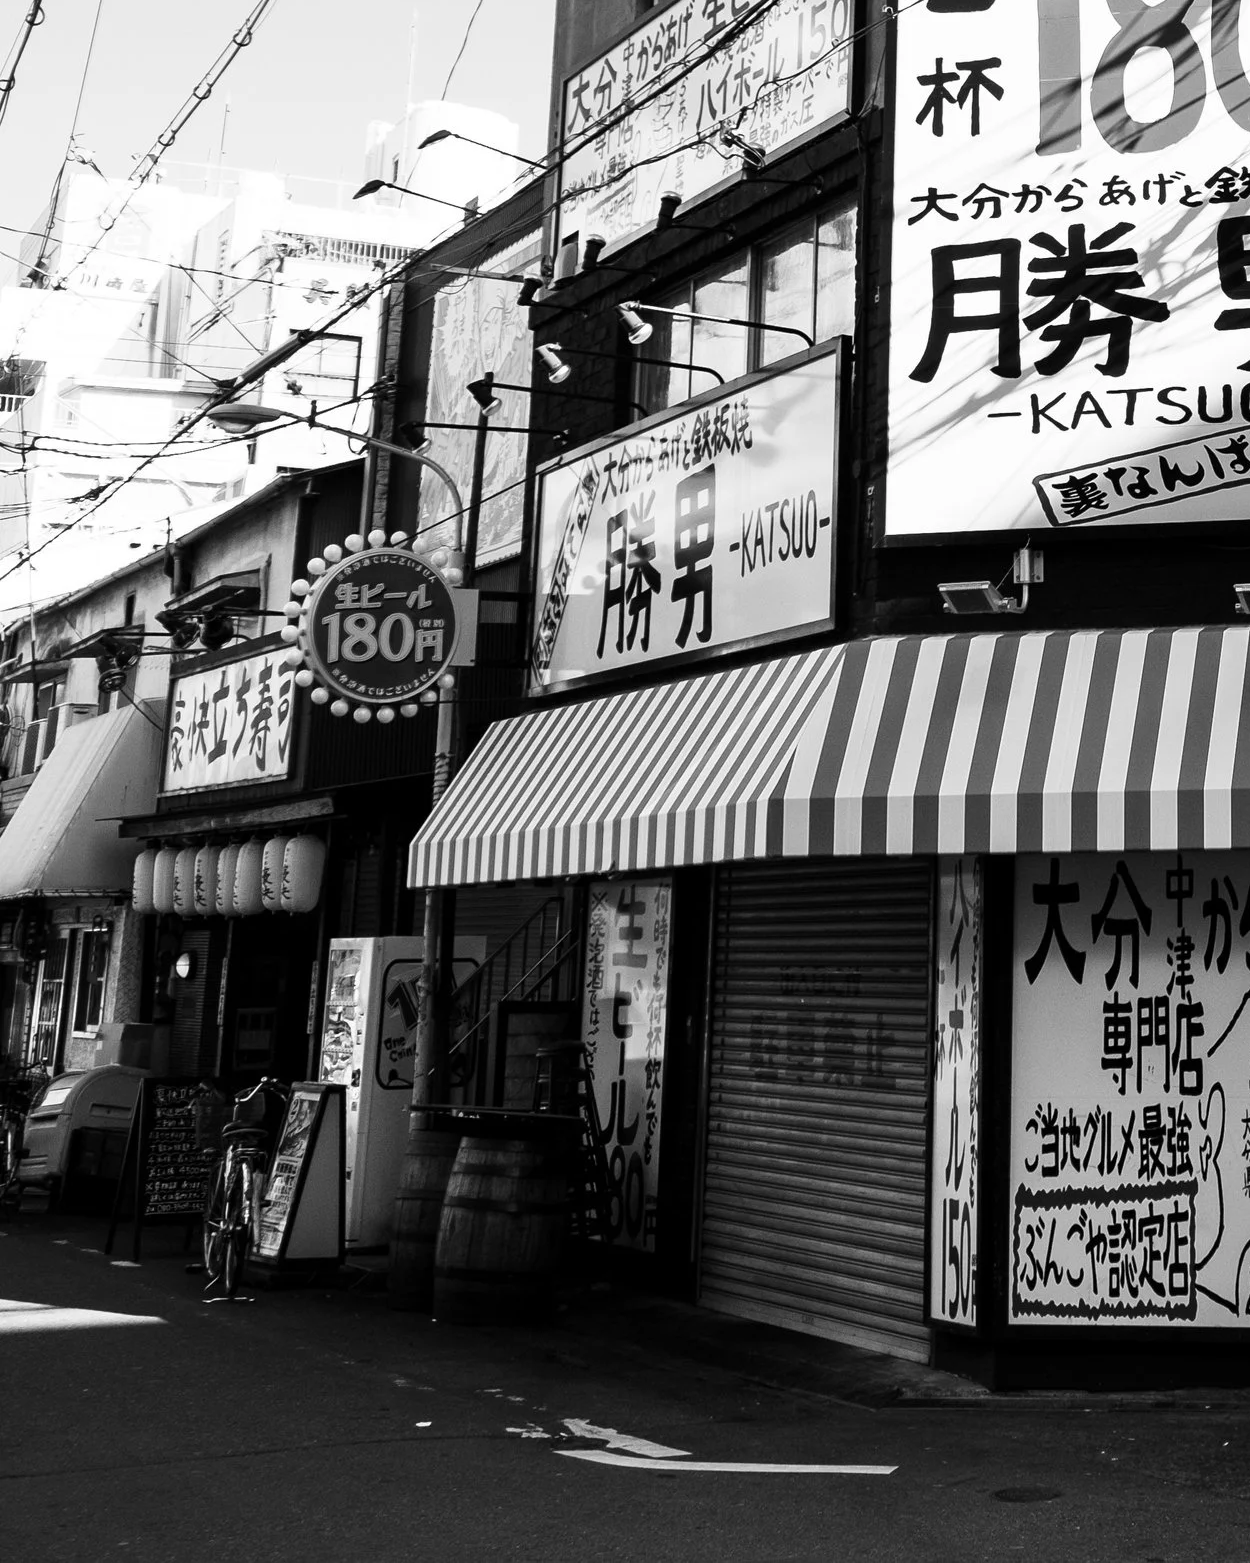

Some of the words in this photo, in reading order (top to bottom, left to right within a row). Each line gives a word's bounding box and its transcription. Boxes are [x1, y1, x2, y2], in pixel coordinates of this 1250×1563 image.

[334, 582, 433, 610] 生ビール
[596, 462, 717, 660] 勝男
[169, 656, 296, 773] 豪快立ち寿司
[1024, 857, 1153, 991] 大分
[1166, 854, 1195, 1000] 中津
[600, 883, 649, 1147] 生ビール
[945, 858, 970, 1193] ハイボール
[1101, 991, 1205, 1097] 専門店
[1024, 1101, 1195, 1182] ご当地グルメ最強
[1020, 1200, 1192, 1300] ぶんごや認定店
